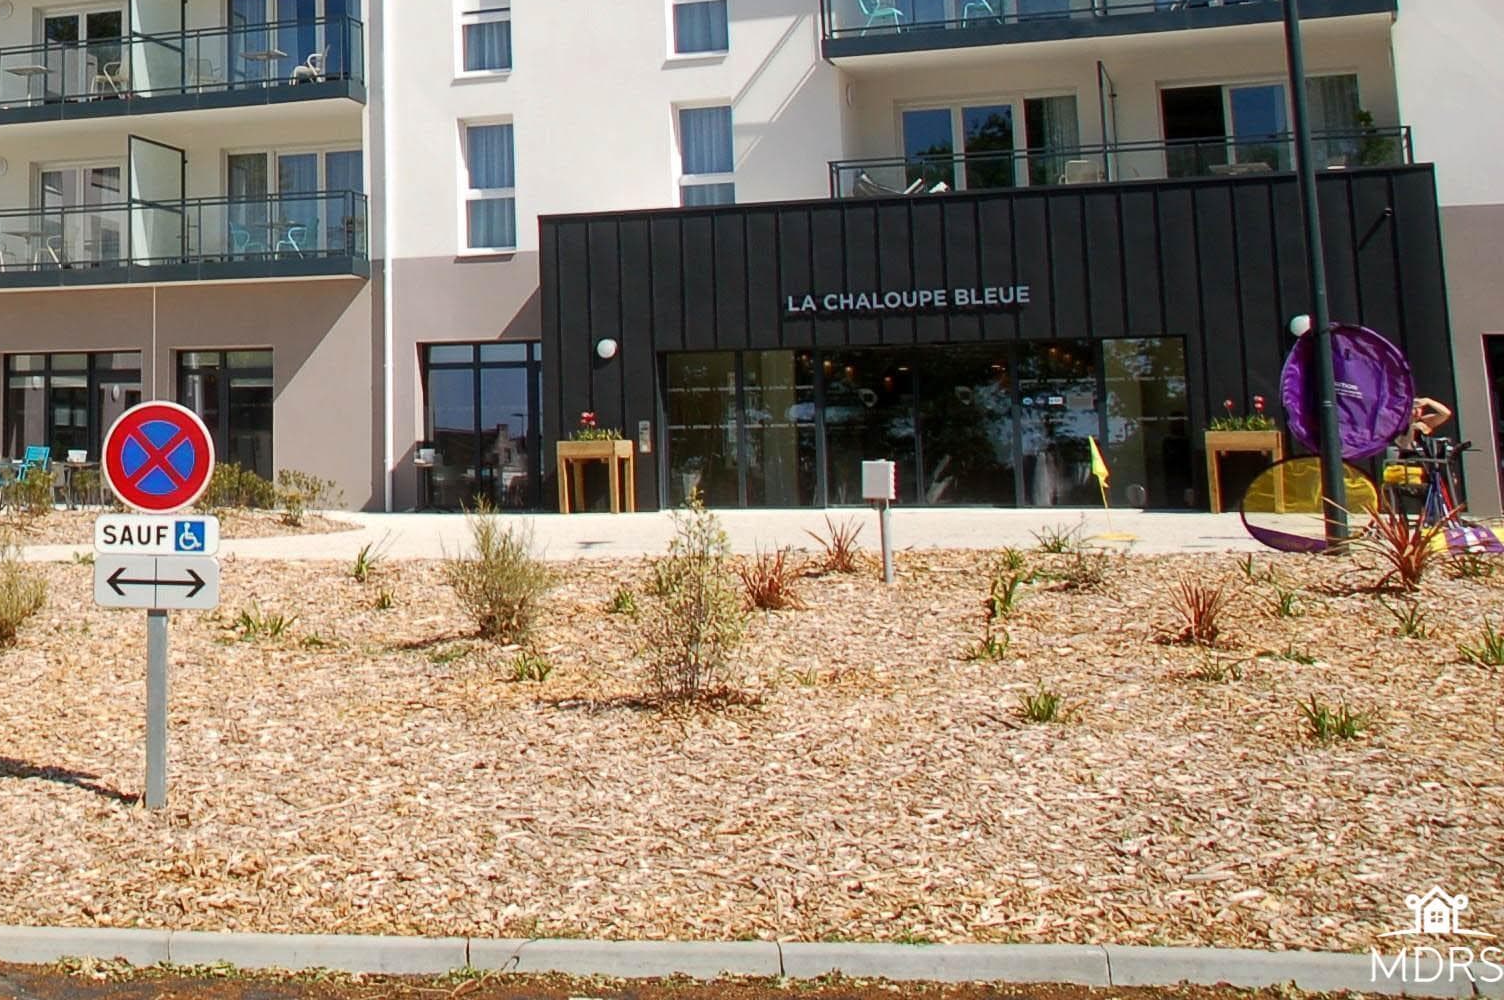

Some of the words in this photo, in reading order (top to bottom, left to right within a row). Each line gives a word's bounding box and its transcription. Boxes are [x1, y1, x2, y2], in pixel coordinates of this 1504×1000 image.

[788, 294, 816, 311] LA
[823, 290, 947, 310] CHALOUPE
[954, 285, 1030, 305] BLEUE
[103, 525, 168, 545] SAUF
